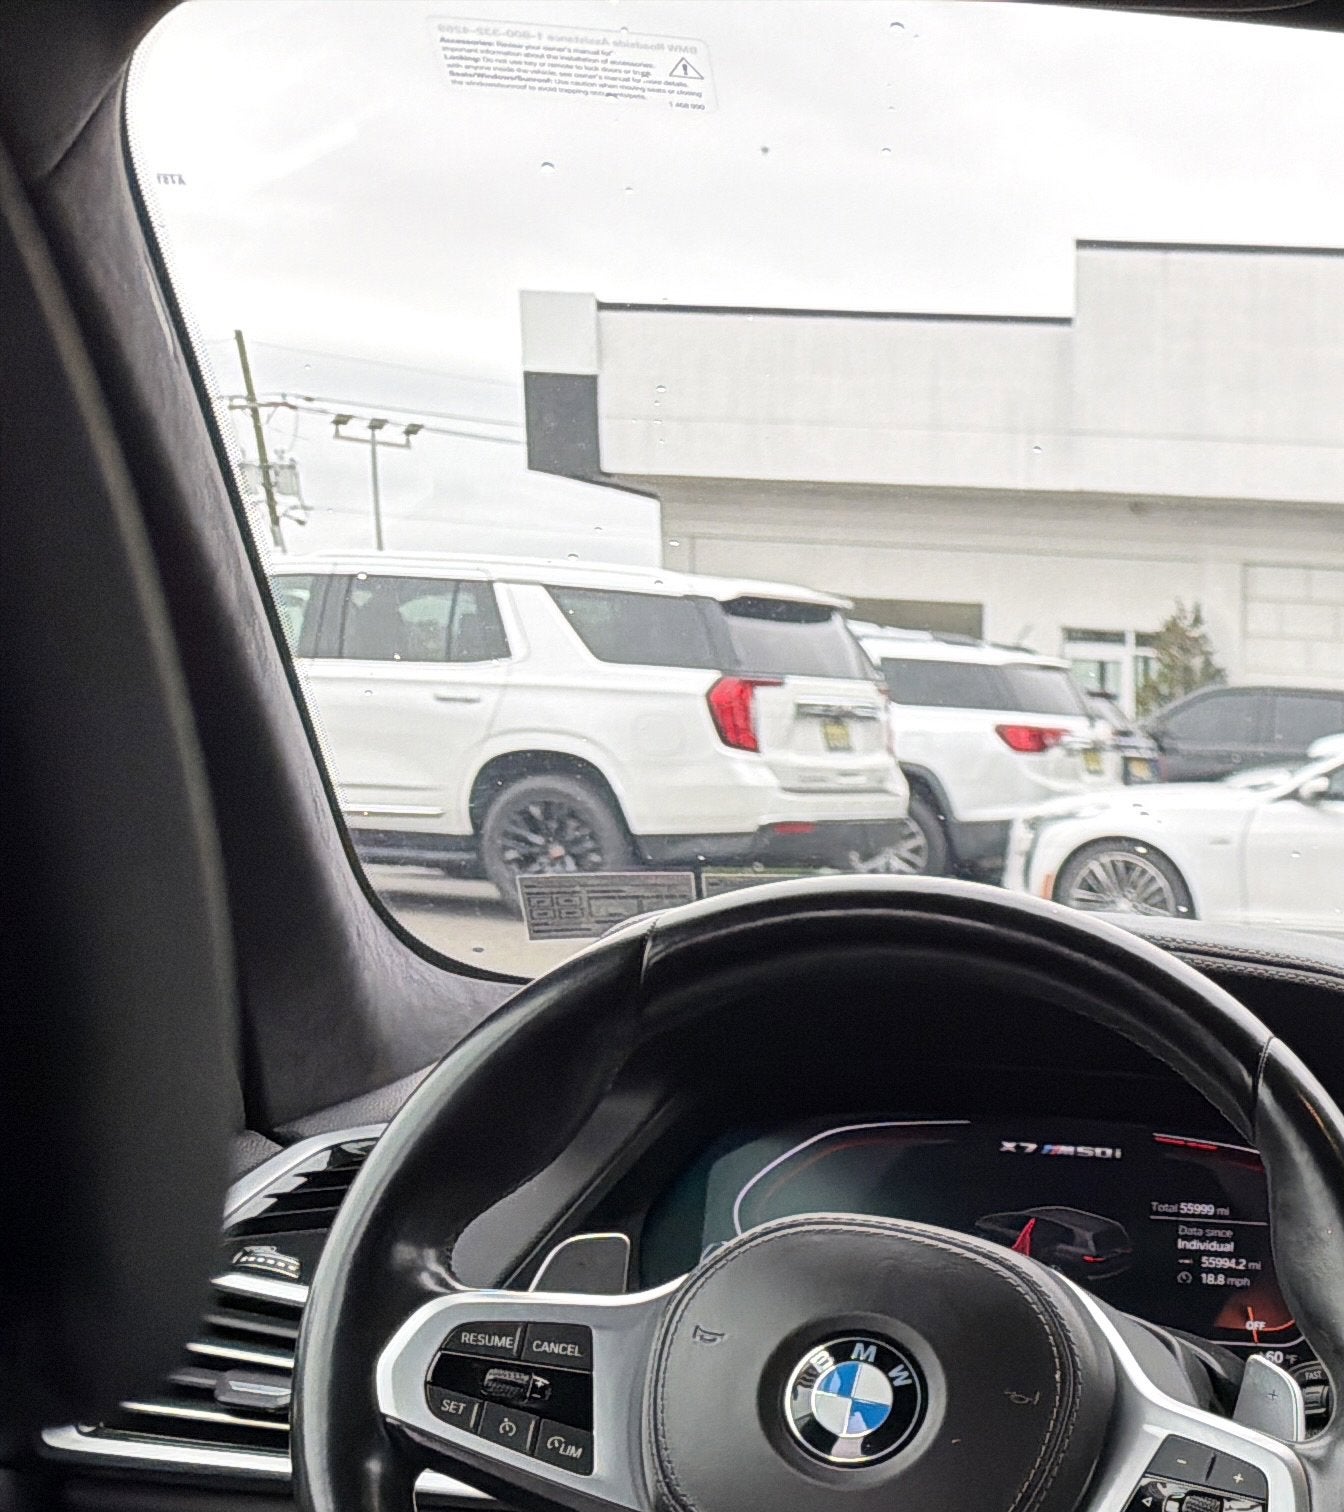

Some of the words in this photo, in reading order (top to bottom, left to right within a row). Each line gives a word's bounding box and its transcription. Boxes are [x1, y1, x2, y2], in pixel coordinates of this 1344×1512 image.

[1000, 1141, 1038, 1153] X7
[1151, 1201, 1178, 1213] Total
[1179, 1202, 1215, 1216] 55999
[1178, 1225, 1203, 1237] Data
[1205, 1227, 1233, 1238] since
[1177, 1239, 1234, 1252] Individual
[1201, 1256, 1246, 1270] 55994.2
[1201, 1273, 1225, 1285] 18.8
[1226, 1276, 1250, 1287] mph
[1246, 1321, 1266, 1331] OFF
[461, 1332, 514, 1348] RESUME
[532, 1340, 583, 1357] CANCEL
[810, 1342, 912, 1387] BMW
[441, 1399, 466, 1415] SET
[559, 1444, 583, 1459] LIM
